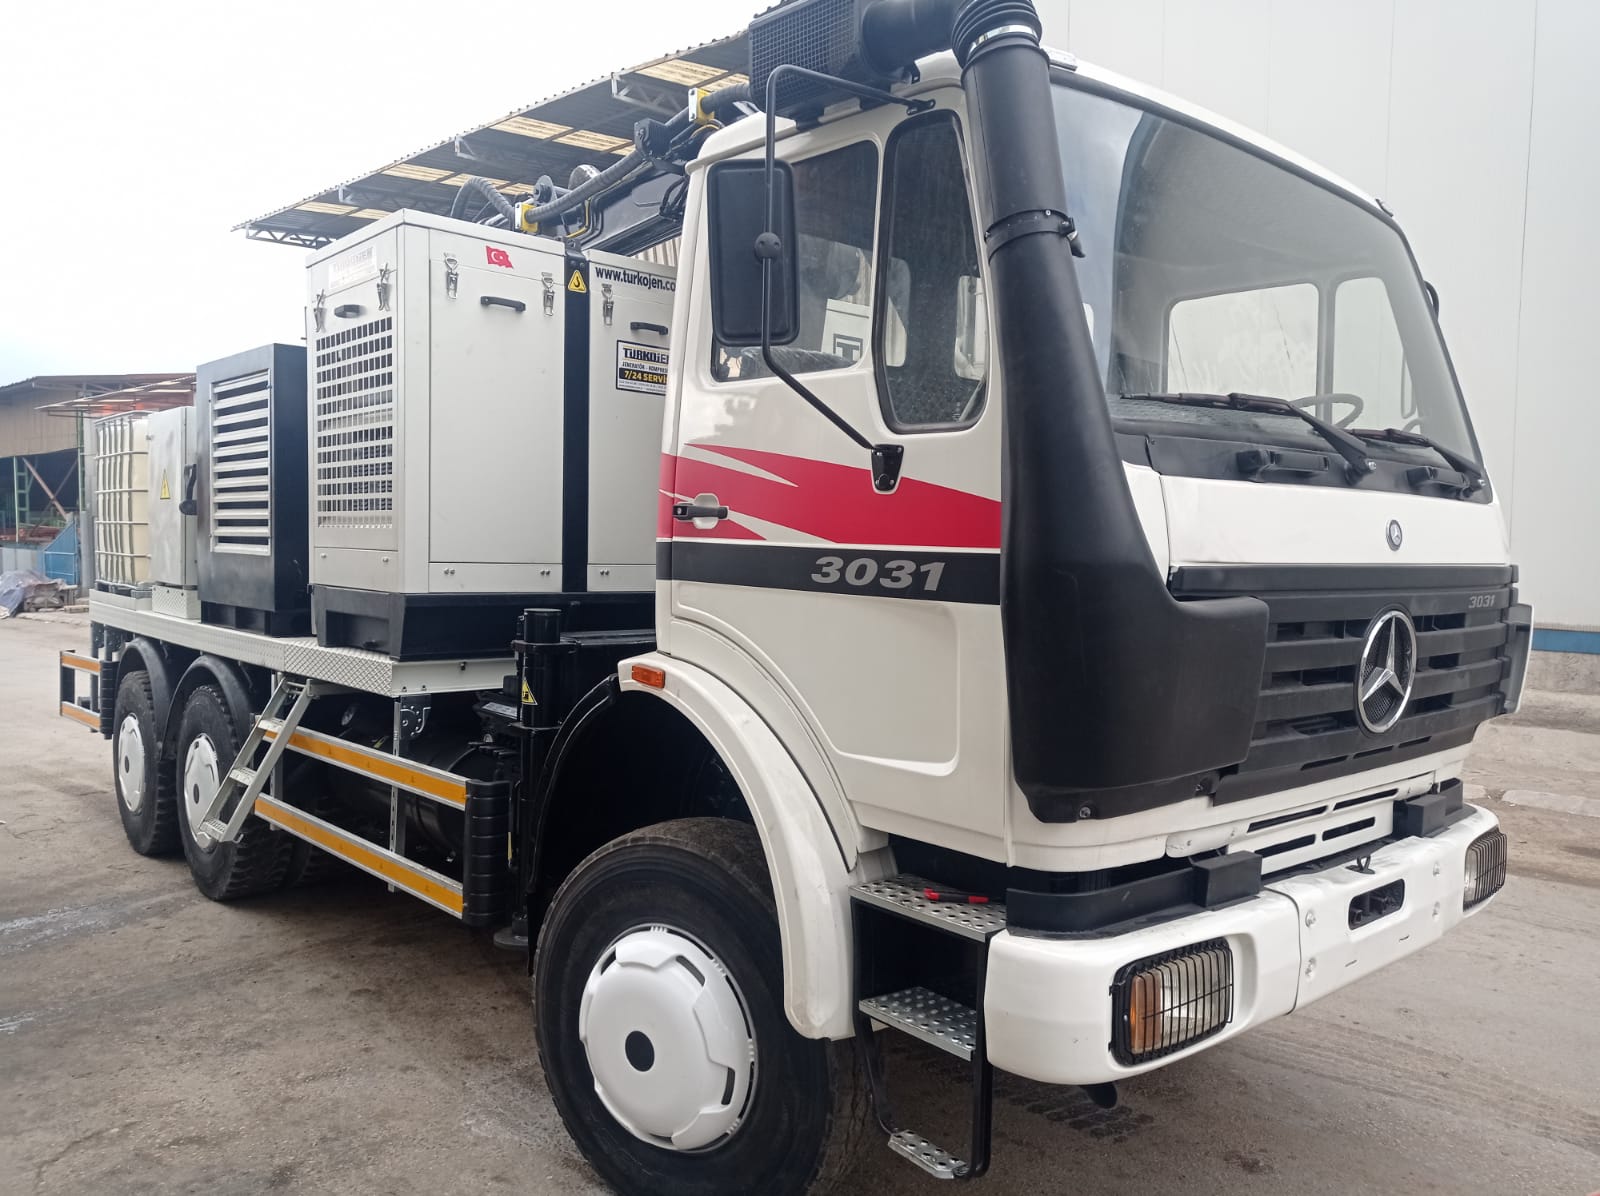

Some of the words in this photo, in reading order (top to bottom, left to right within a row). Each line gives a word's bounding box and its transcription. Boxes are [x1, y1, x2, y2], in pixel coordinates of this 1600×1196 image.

[595, 266, 676, 292] www.turkojen.co
[624, 370, 642, 380] 7/24
[643, 373, 669, 384] SERVİ
[811, 556, 945, 591] 3031
[1468, 594, 1496, 609] 3031
